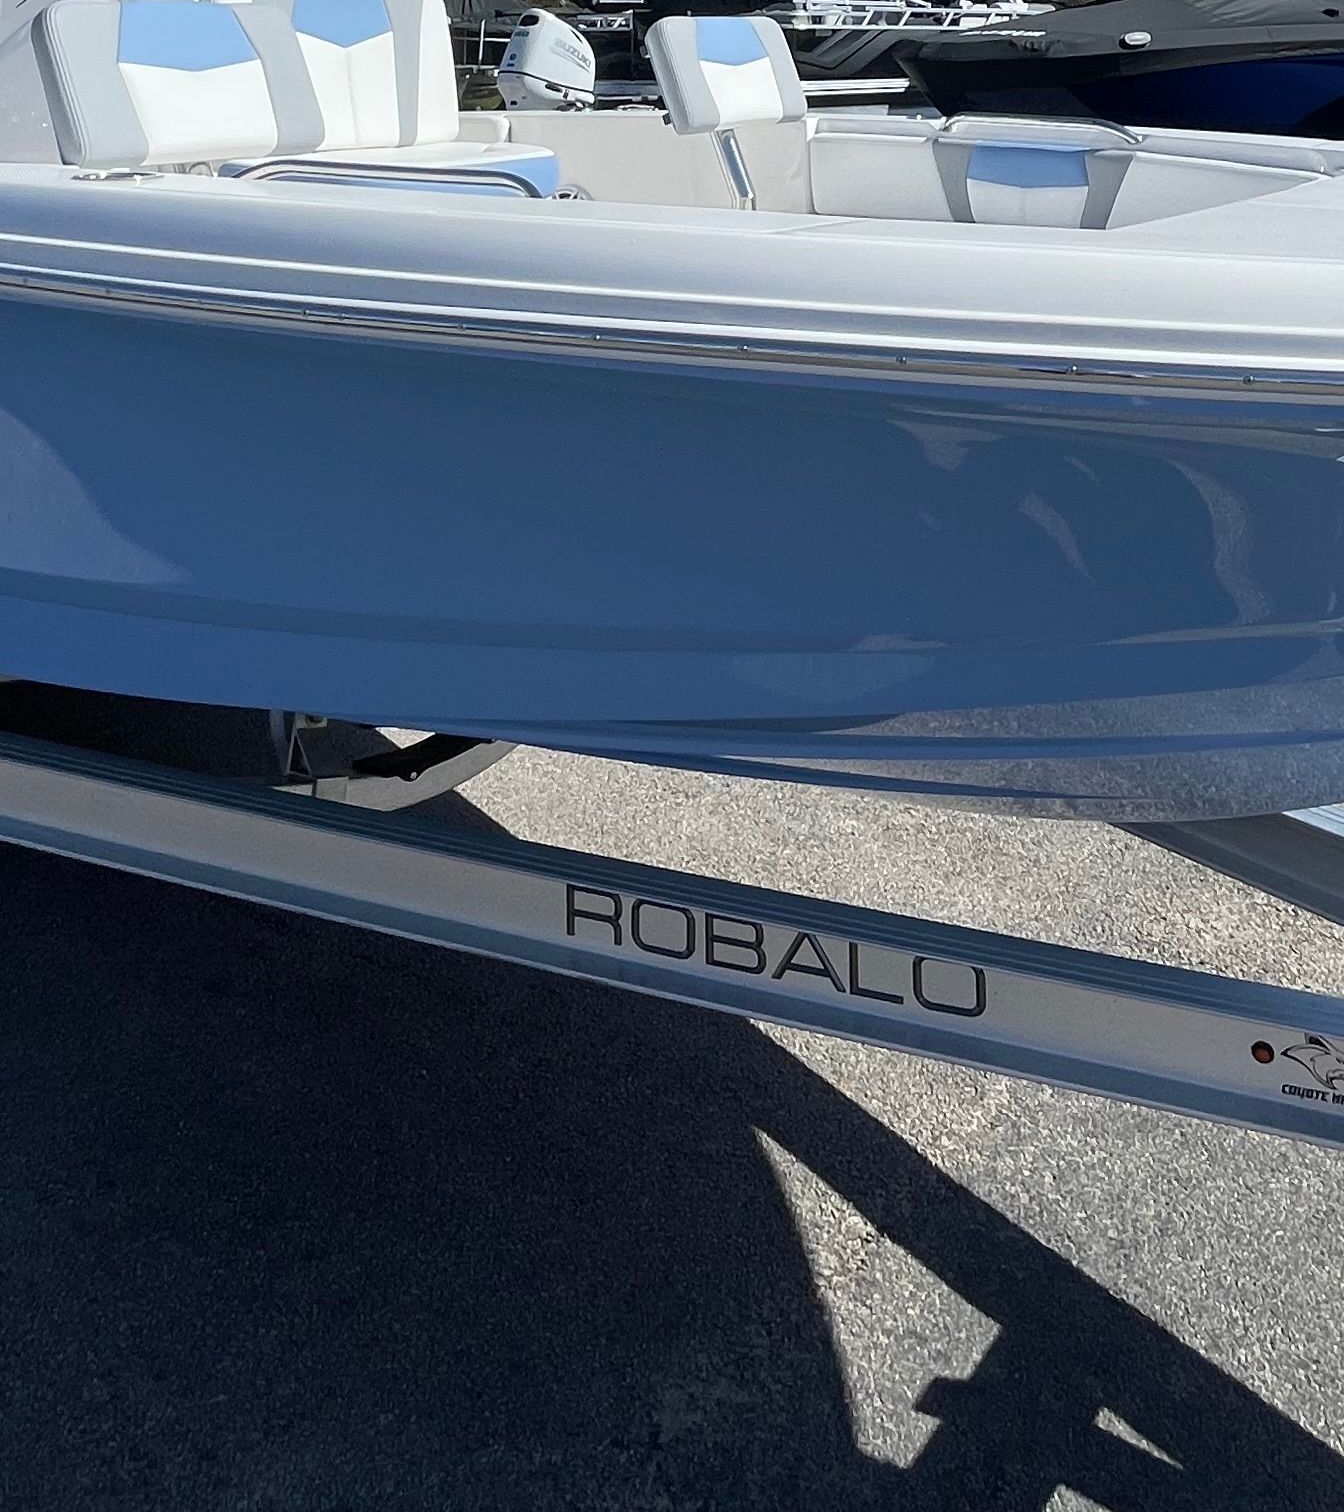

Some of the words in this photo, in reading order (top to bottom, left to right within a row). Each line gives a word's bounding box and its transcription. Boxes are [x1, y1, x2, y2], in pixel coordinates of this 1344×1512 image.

[554, 38, 592, 69] SUZUKI
[566, 883, 987, 1018] ROBALO
[1281, 1084, 1330, 1103] COYOTE
